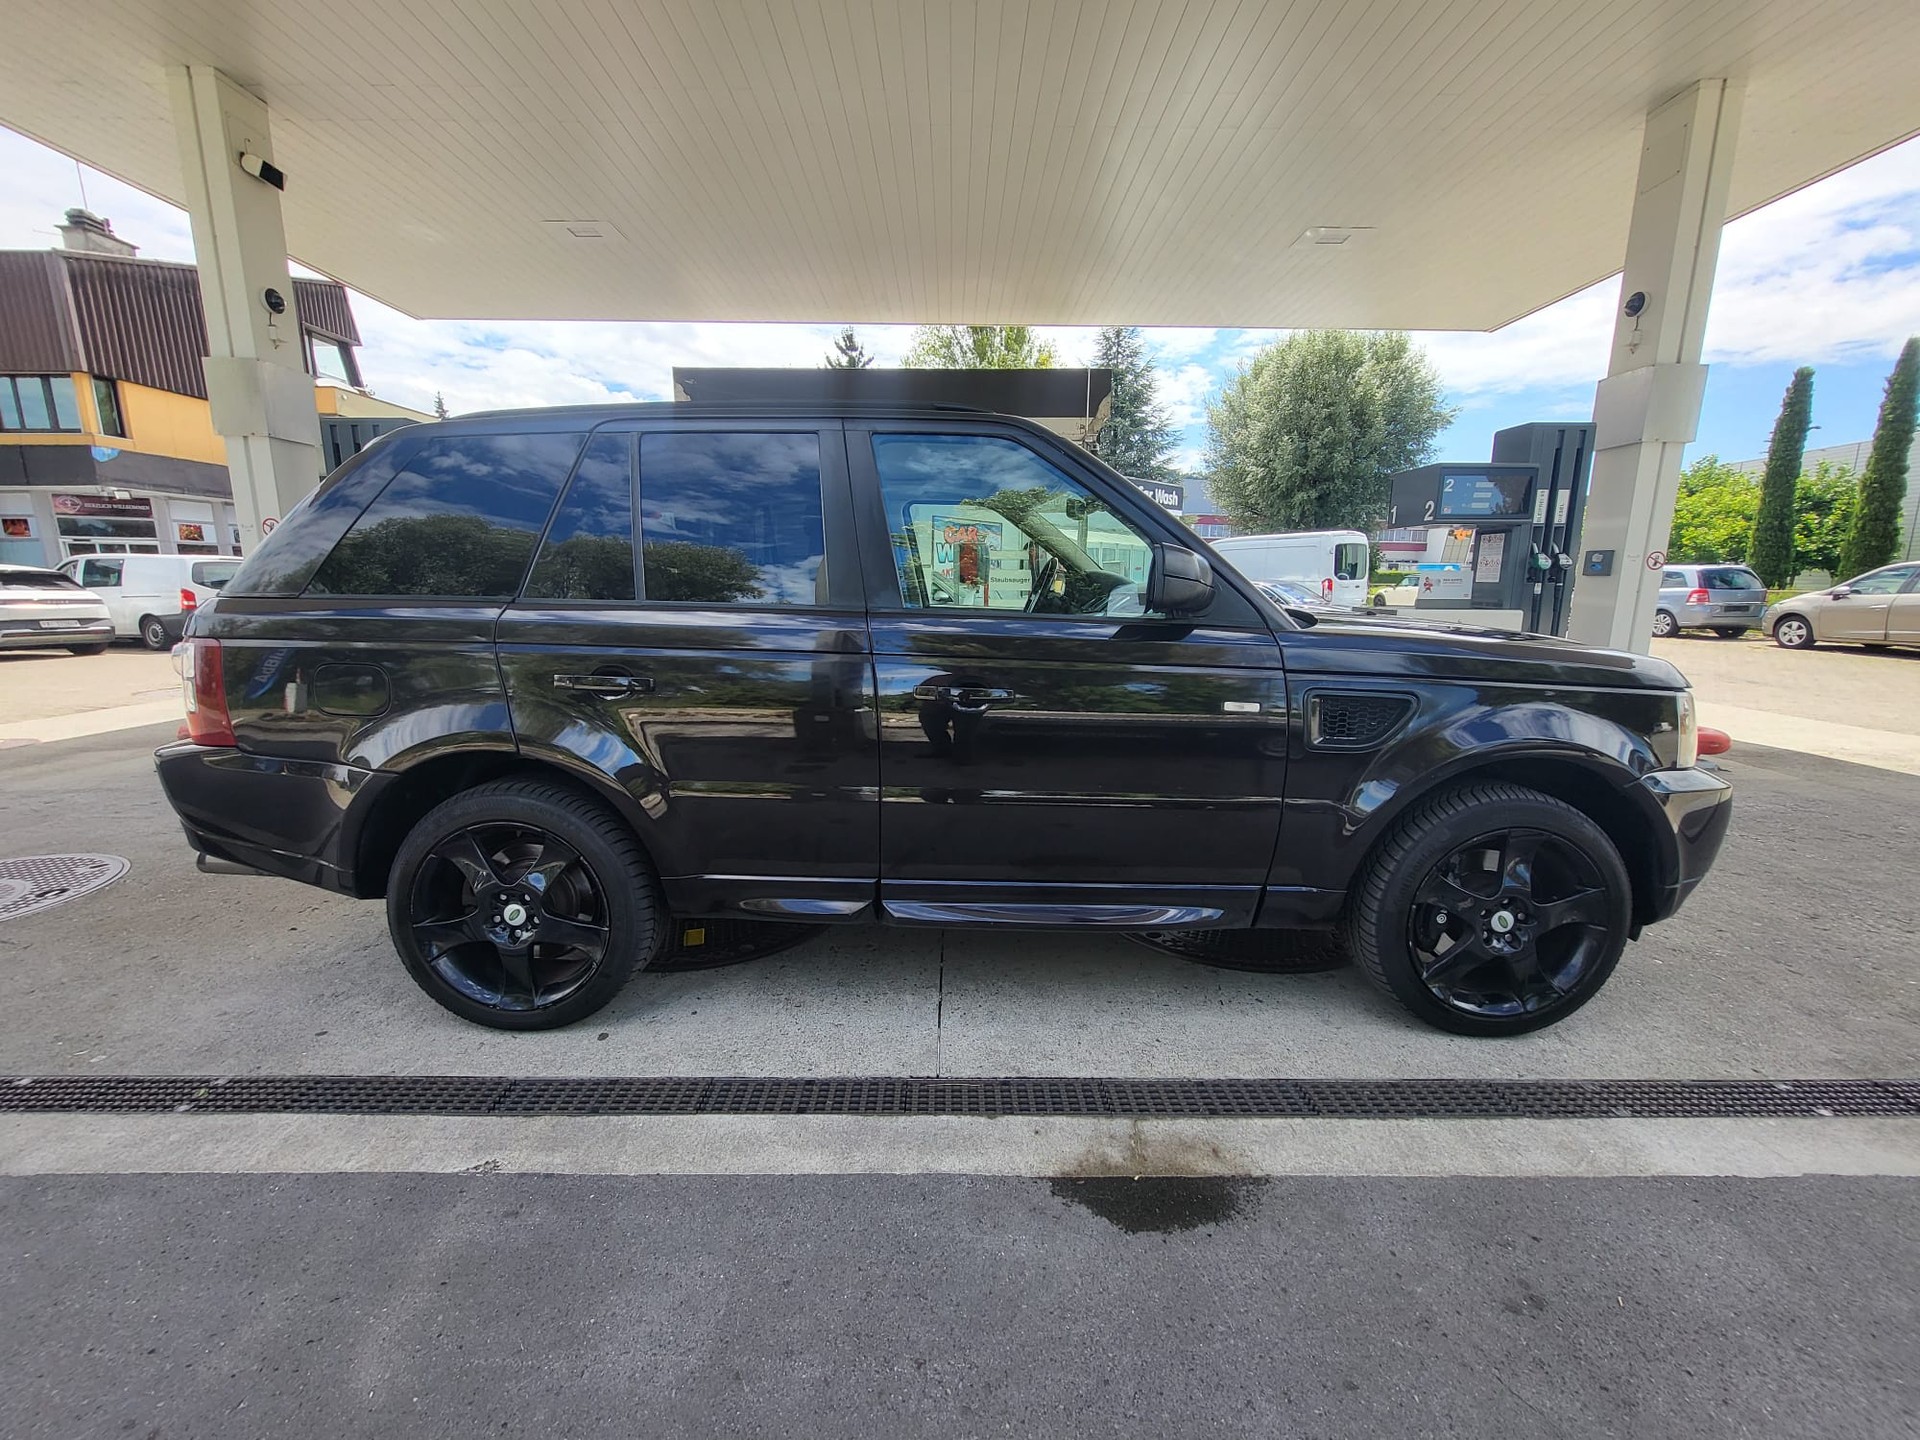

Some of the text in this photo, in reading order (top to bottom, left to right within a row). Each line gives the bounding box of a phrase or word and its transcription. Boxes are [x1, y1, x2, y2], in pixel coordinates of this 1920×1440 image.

[1443, 478, 1455, 492] 2
[1155, 488, 1178, 506] Wash
[1390, 505, 1398, 524] 1
[1423, 500, 1435, 521] 2
[943, 525, 978, 544] CAR
[990, 576, 1030, 585] Staubsauger
[254, 648, 288, 683] AdBlu
